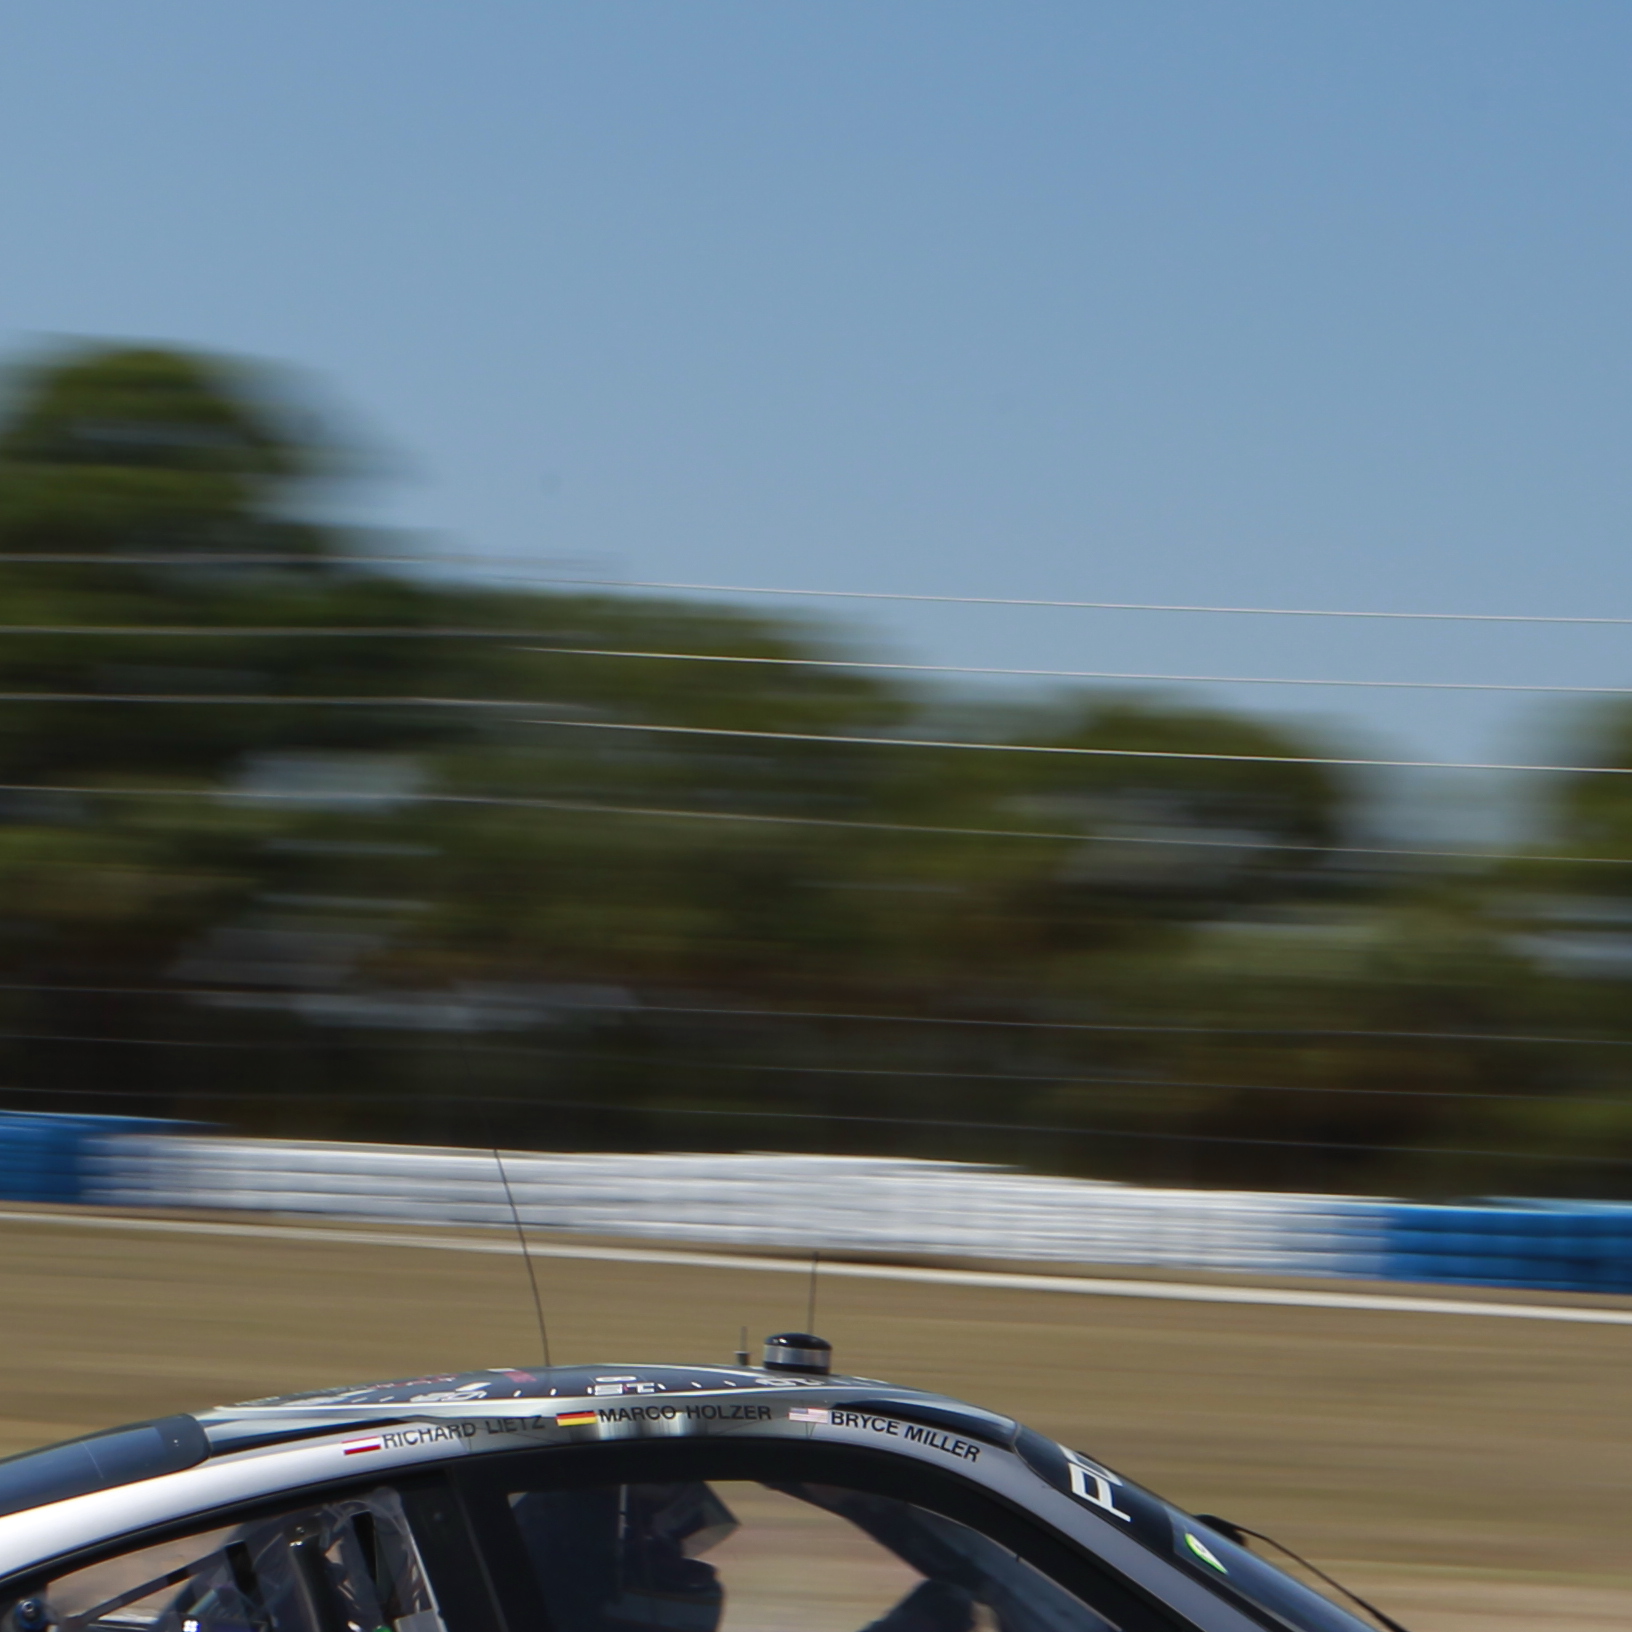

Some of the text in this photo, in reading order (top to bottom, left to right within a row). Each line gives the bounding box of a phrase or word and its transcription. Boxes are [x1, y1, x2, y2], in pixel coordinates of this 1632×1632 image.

[382, 1414, 545, 1449] RICHARD LIETZ
[598, 1405, 771, 1423] MARCO HOLZER
[831, 1411, 981, 1463] BRYCE MILLER
